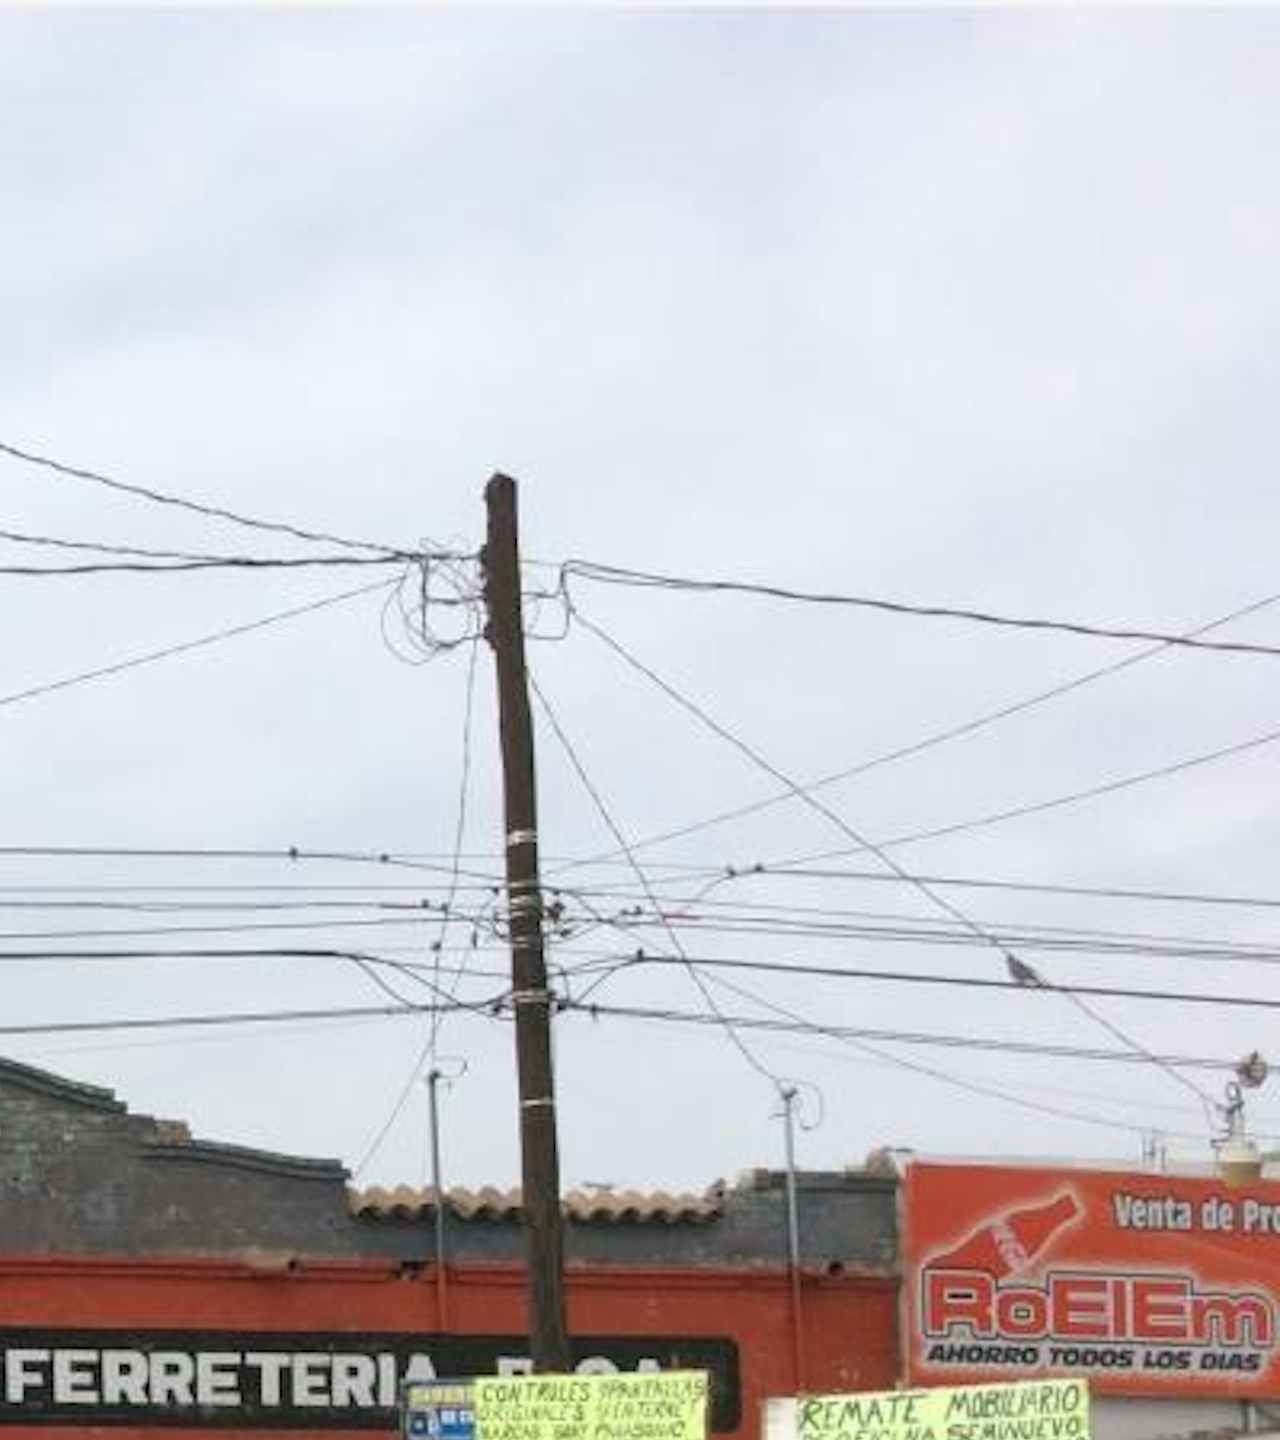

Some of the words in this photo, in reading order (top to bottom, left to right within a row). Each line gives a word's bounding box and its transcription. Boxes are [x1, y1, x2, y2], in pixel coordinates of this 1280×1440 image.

[1114, 1193, 1192, 1229] Venta
[1202, 1198, 1233, 1230] de
[927, 1344, 1039, 1364] AHORRO
[1049, 1348, 1134, 1368] TODOS
[1143, 1351, 1193, 1368] LOS
[1200, 1353, 1261, 1371] DIAS
[799, 1396, 924, 1431] REMATE
